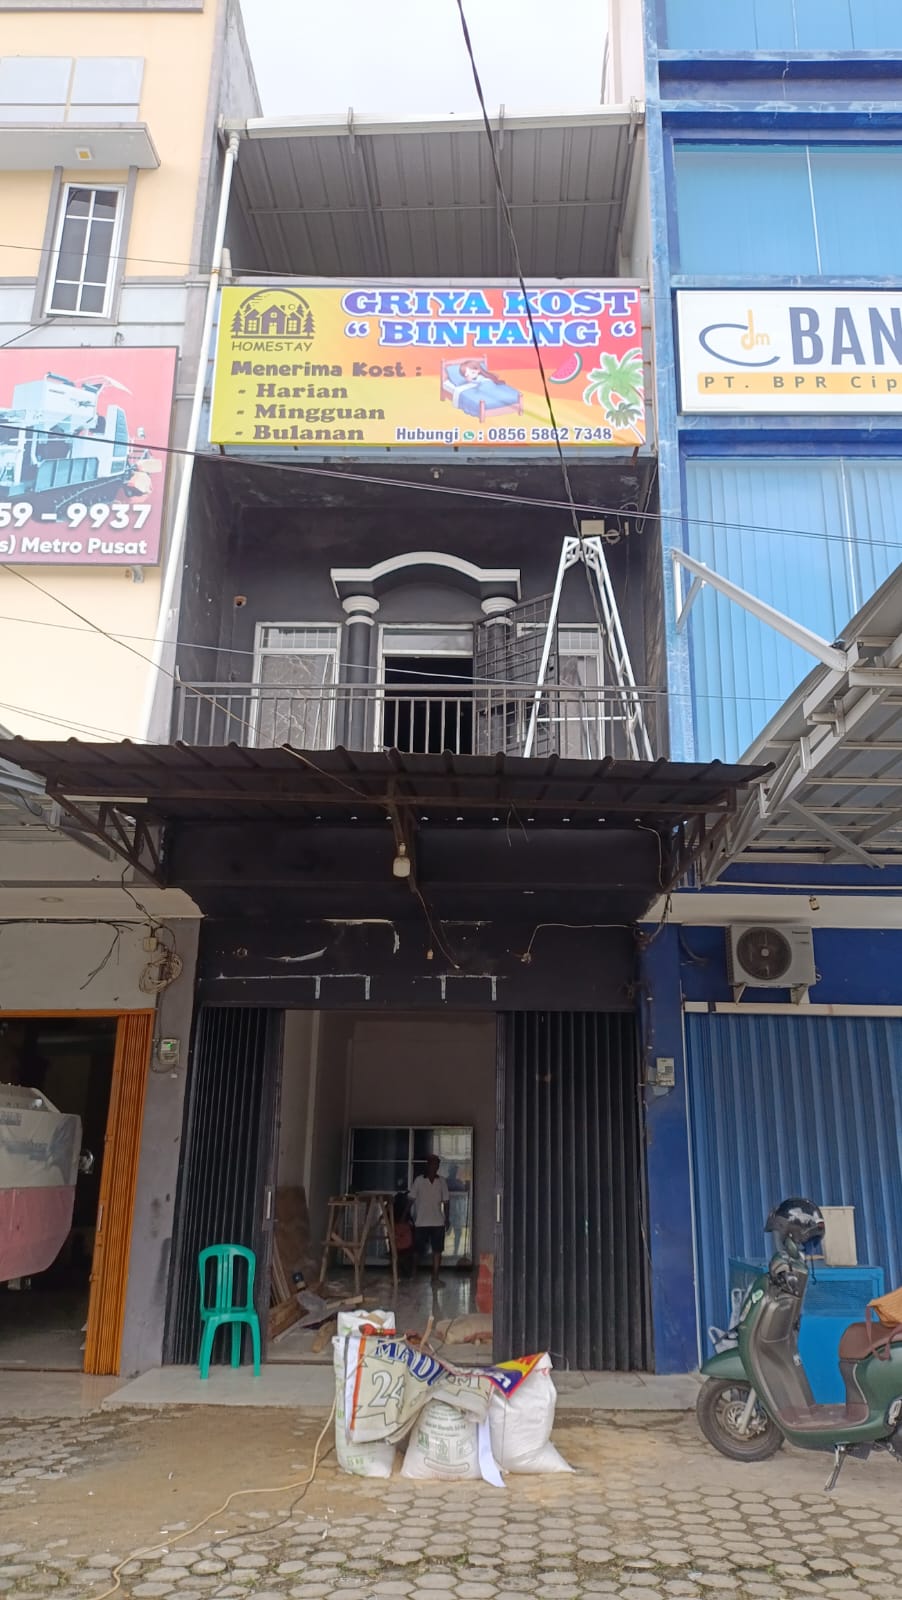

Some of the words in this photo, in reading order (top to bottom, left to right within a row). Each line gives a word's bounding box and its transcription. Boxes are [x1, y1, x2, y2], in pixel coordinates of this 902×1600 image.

[342, 290, 493, 316] GRIYA
[503, 290, 638, 316] KOST
[379, 319, 601, 346] BINTANG
[788, 307, 902, 365] BAN
[231, 341, 313, 352] HOMESTAY
[231, 360, 343, 377] Menerima
[352, 361, 406, 378] Kost
[256, 383, 348, 399] Harian
[704, 376, 750, 388] PT.
[773, 376, 827, 388] BPR
[850, 375, 898, 391] Cip
[254, 403, 386, 422] Mingguan
[252, 425, 365, 441] Bulanan
[396, 428, 459, 443] Hubungi
[488, 428, 526, 440] 0856
[531, 428, 569, 441] 5862
[574, 428, 612, 440] 7348
[67, 503, 151, 529] 9937
[21, 537, 82, 553] Metro
[88, 537, 148, 554] Pusat
